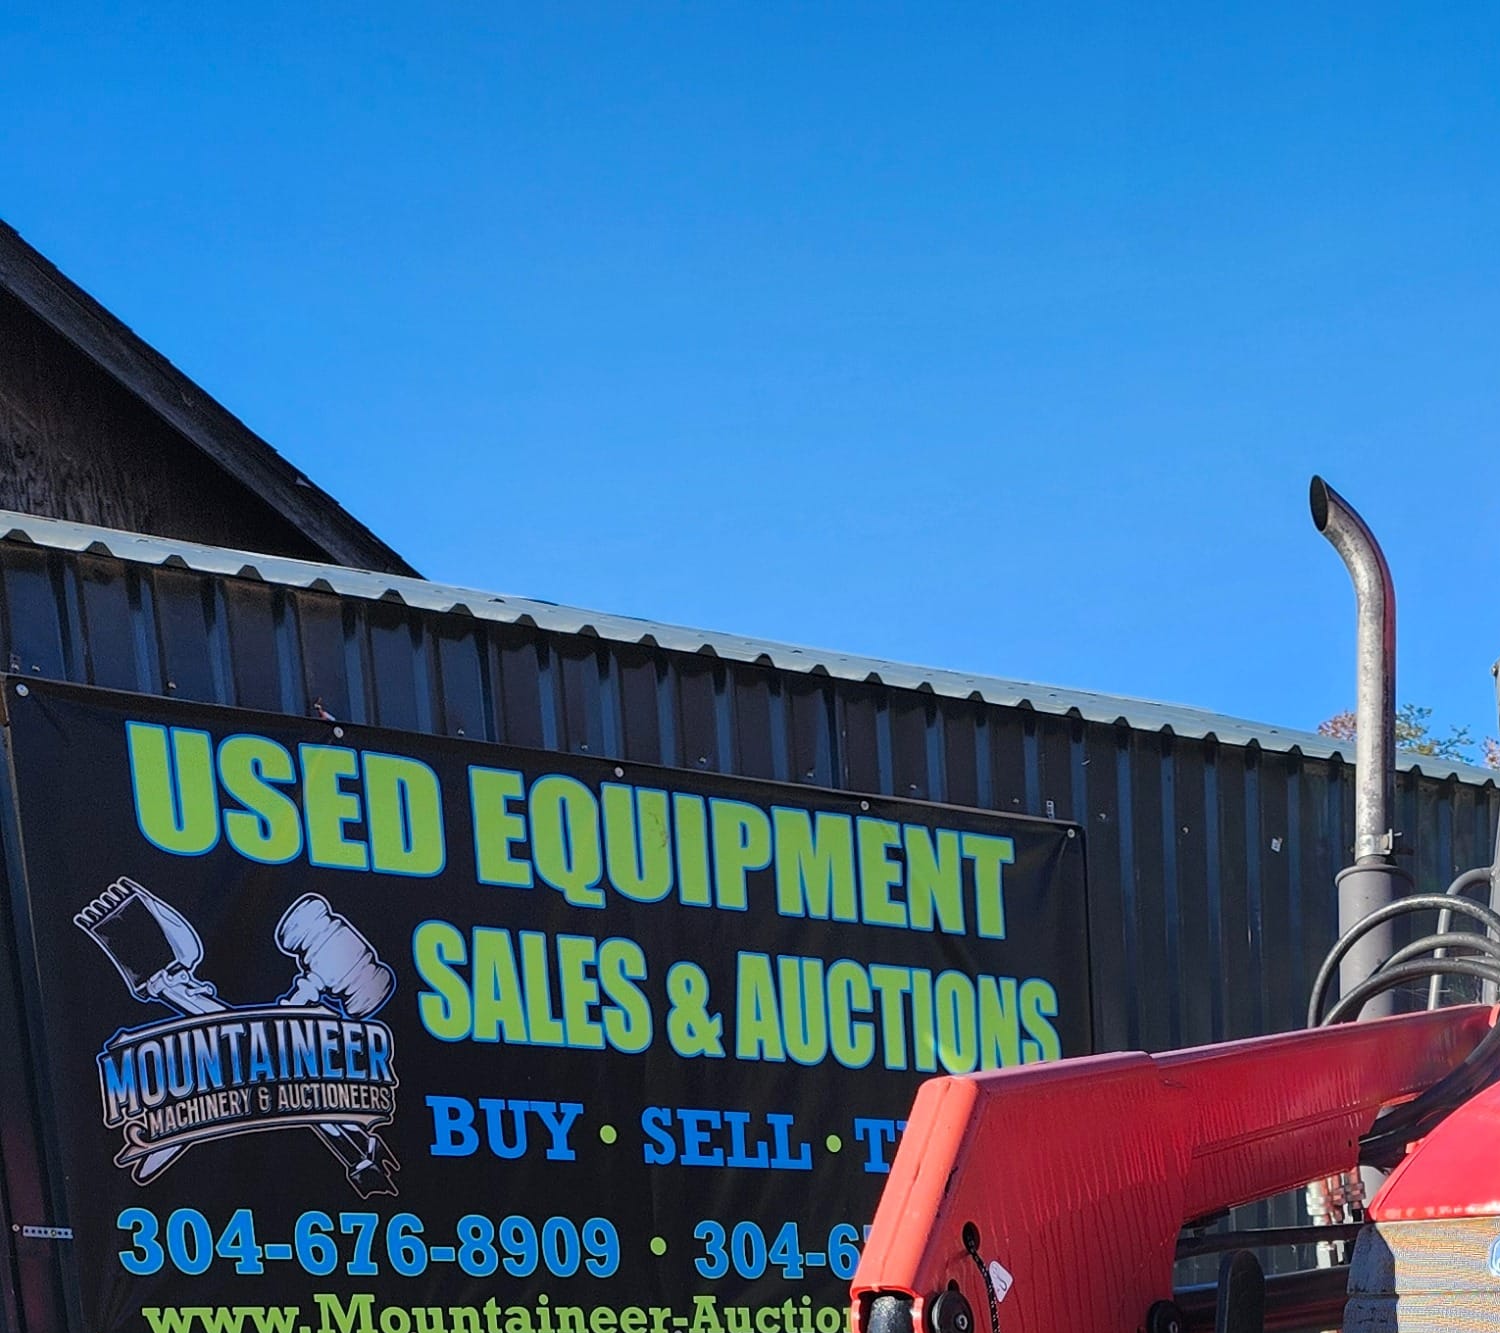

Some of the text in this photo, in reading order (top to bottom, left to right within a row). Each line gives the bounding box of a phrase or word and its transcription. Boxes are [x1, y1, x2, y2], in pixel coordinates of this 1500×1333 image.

[125, 720, 1014, 940] USED EQUIPMENT
[412, 920, 1061, 1074] SALES & AUCTIONS
[103, 1018, 396, 1122] MOUNTAINEER
[150, 1084, 392, 1137] MACHINERY & AUCTIONEERS
[425, 1095, 583, 1161] BUY
[642, 1106, 813, 1170] SELL
[116, 1208, 873, 1281] 304-676-8909 304-6
